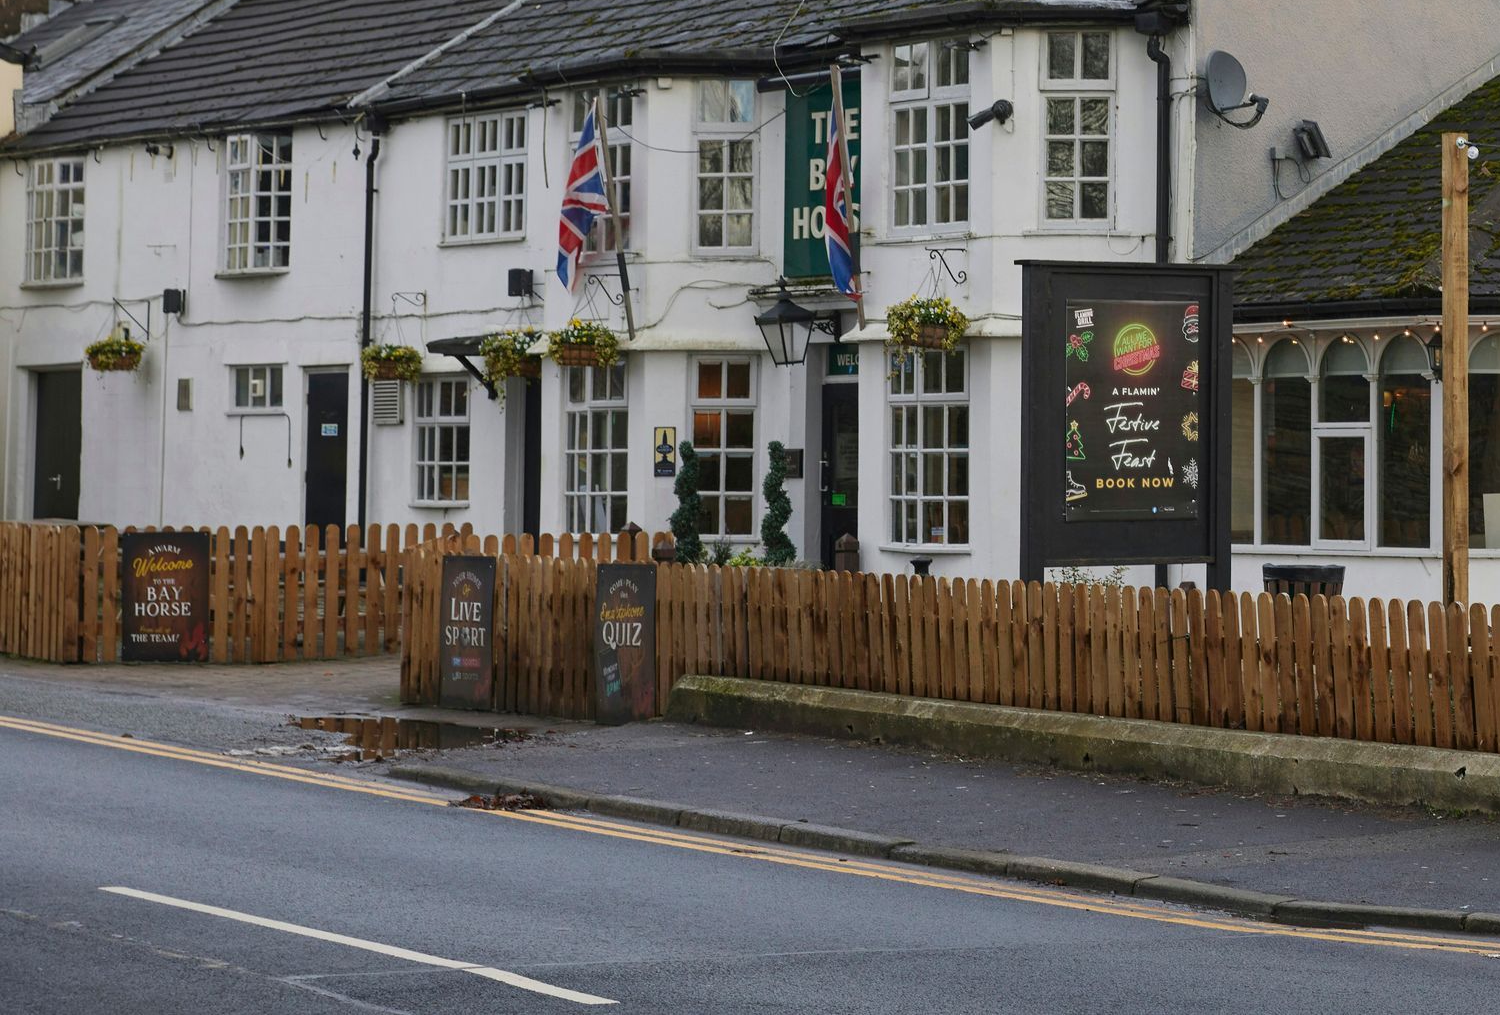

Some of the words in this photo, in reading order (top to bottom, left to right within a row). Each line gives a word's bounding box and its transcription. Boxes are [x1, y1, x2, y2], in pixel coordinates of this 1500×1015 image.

[809, 155, 858, 191] BY
[1121, 334, 1136, 346] ALL
[1135, 330, 1148, 341] WE
[836, 353, 859, 366] WELC
[1112, 387, 1119, 396] A
[1122, 387, 1160, 396] FLAMIN'
[1103, 401, 1160, 434] Festive
[1108, 438, 1157, 471] Feast
[1095, 478, 1136, 489] BOOK
[1142, 476, 1175, 488] NOW
[148, 548, 154, 556] A
[154, 544, 181, 555] WARM
[132, 557, 193, 578] Welcome
[147, 586, 182, 601] BAY
[134, 601, 191, 617] HORSE
[451, 597, 481, 622] LIVE
[131, 634, 148, 642] THE
[150, 634, 180, 643] TEAM!
[602, 621, 642, 649] QUIZ
